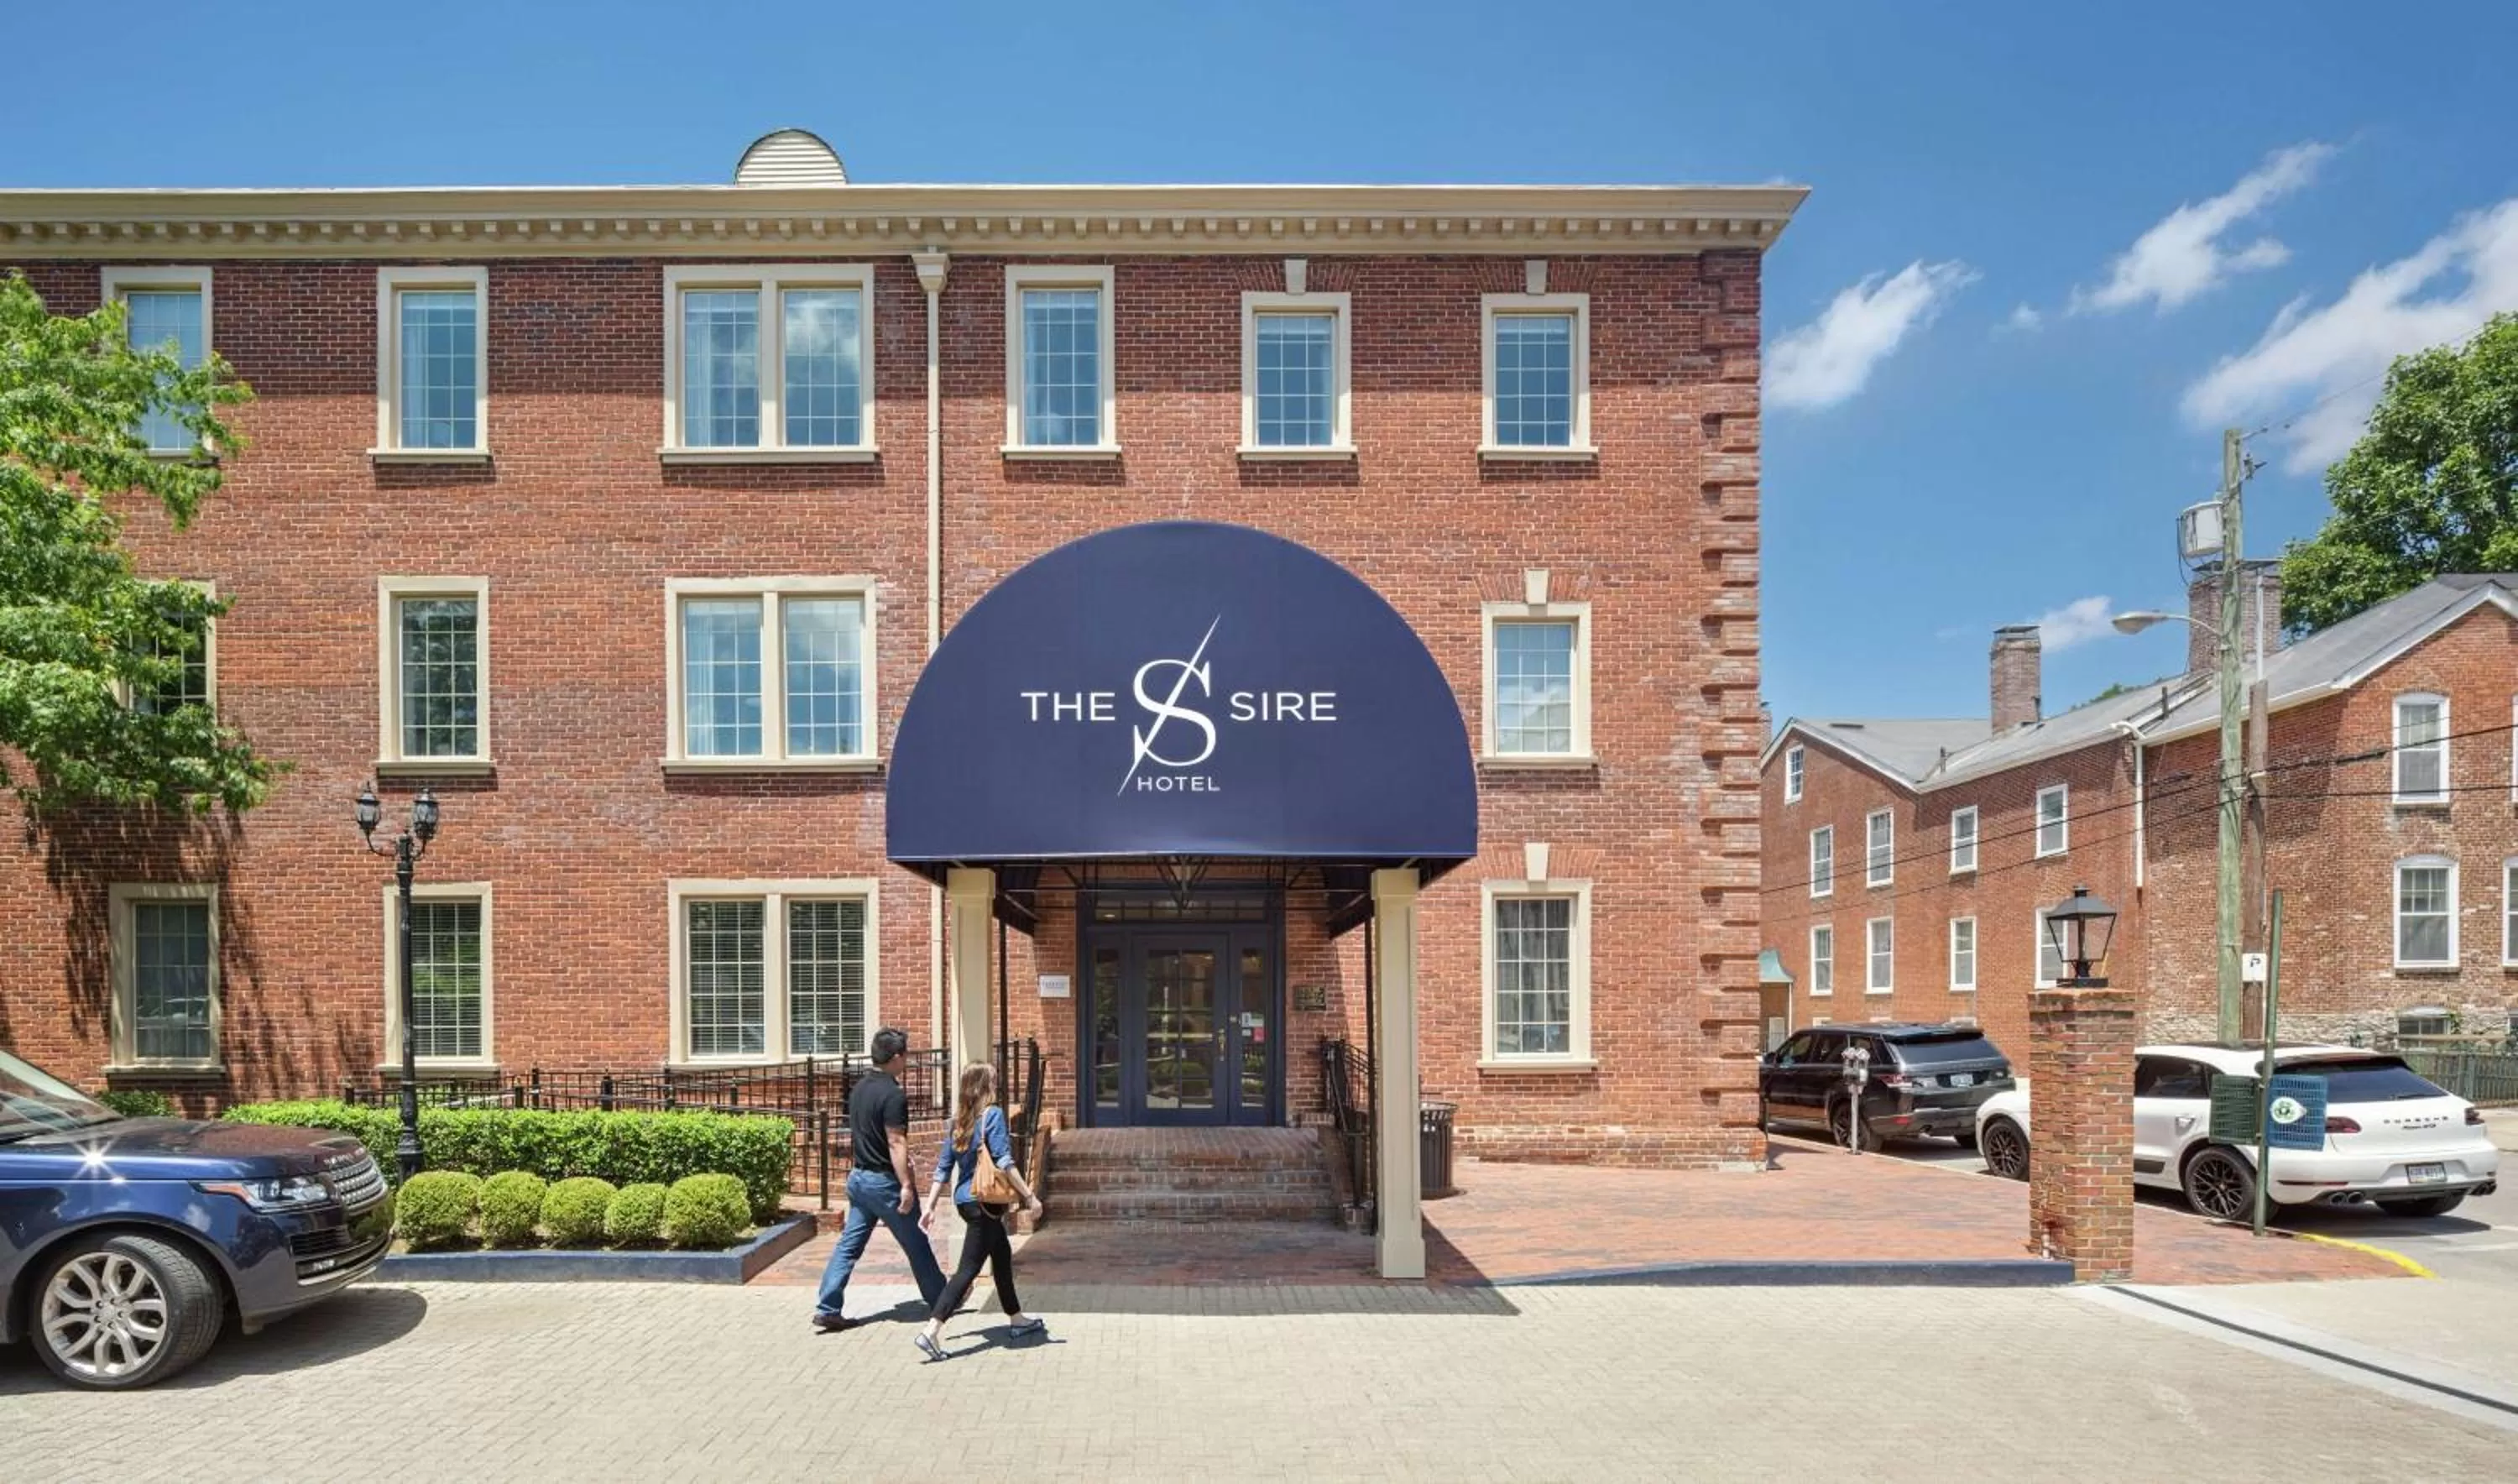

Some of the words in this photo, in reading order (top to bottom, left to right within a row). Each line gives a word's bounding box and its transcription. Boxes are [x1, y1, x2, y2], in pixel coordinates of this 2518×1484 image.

[1020, 691, 1115, 722] THE
[1230, 691, 1337, 722] SIRE
[1137, 776, 1220, 792] HOTEL
